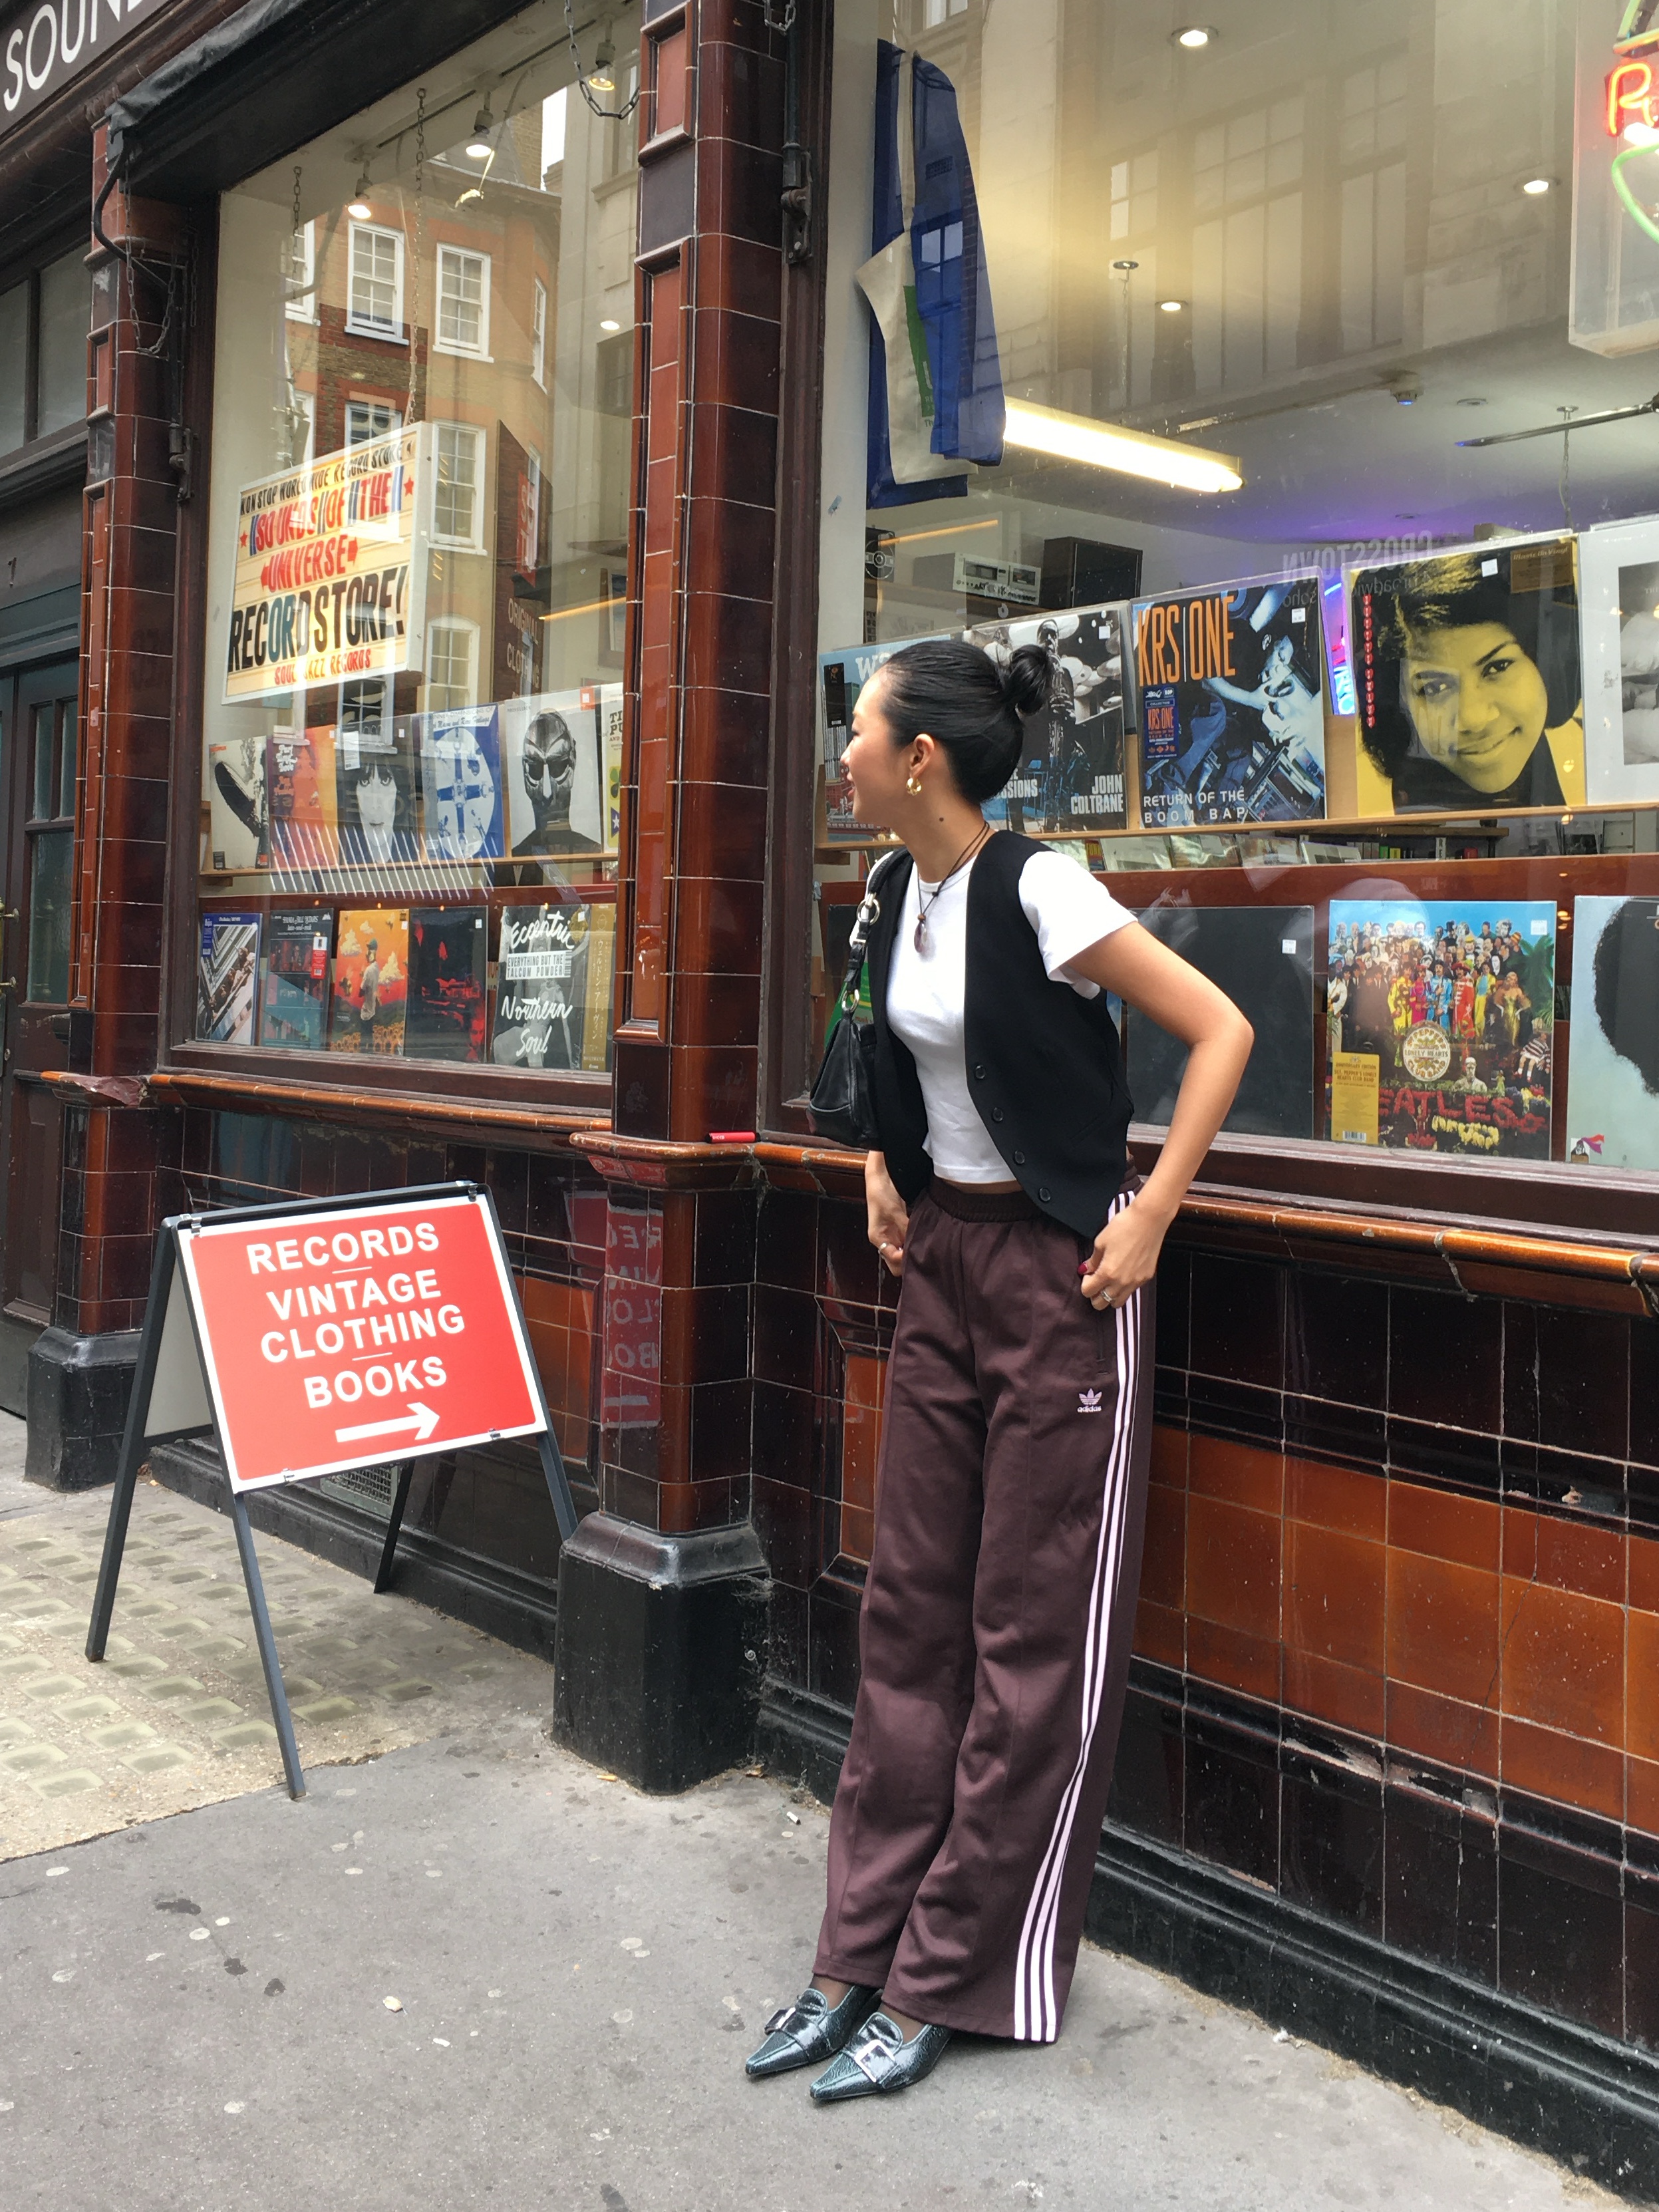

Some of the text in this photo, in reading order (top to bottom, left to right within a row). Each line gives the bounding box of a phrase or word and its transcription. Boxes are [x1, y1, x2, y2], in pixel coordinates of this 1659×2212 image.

[257, 485, 278, 509] STOP
[279, 475, 308, 501] WORLD
[334, 453, 370, 482] RECORD
[255, 472, 392, 552] SOUNDS OF THE
[267, 534, 348, 593] UNIVERSE
[1189, 595, 1236, 681] ONE
[274, 663, 297, 685] SOUL
[330, 648, 371, 675] RECORDS
[506, 642, 539, 689] CLOTHG
[1070, 794, 1124, 815] COLTRANE
[1092, 774, 1123, 794] JOHN
[1143, 789, 1245, 808] RETURN OF THE
[1144, 806, 1246, 824] BOOM BAP
[510, 910, 575, 950] Eccentric
[507, 965, 563, 978] TALCUM POWDER
[508, 954, 563, 967] EVERYTHING BUT THE
[501, 995, 573, 1021] Northern
[516, 1025, 553, 1057] Soul
[1378, 1086, 1523, 1129] EATLES
[245, 1221, 440, 1275] RECORDS
[265, 1268, 442, 1321] VINTAGE
[260, 1304, 465, 1364] CLOTHING
[303, 1355, 447, 1409] BOOKS
